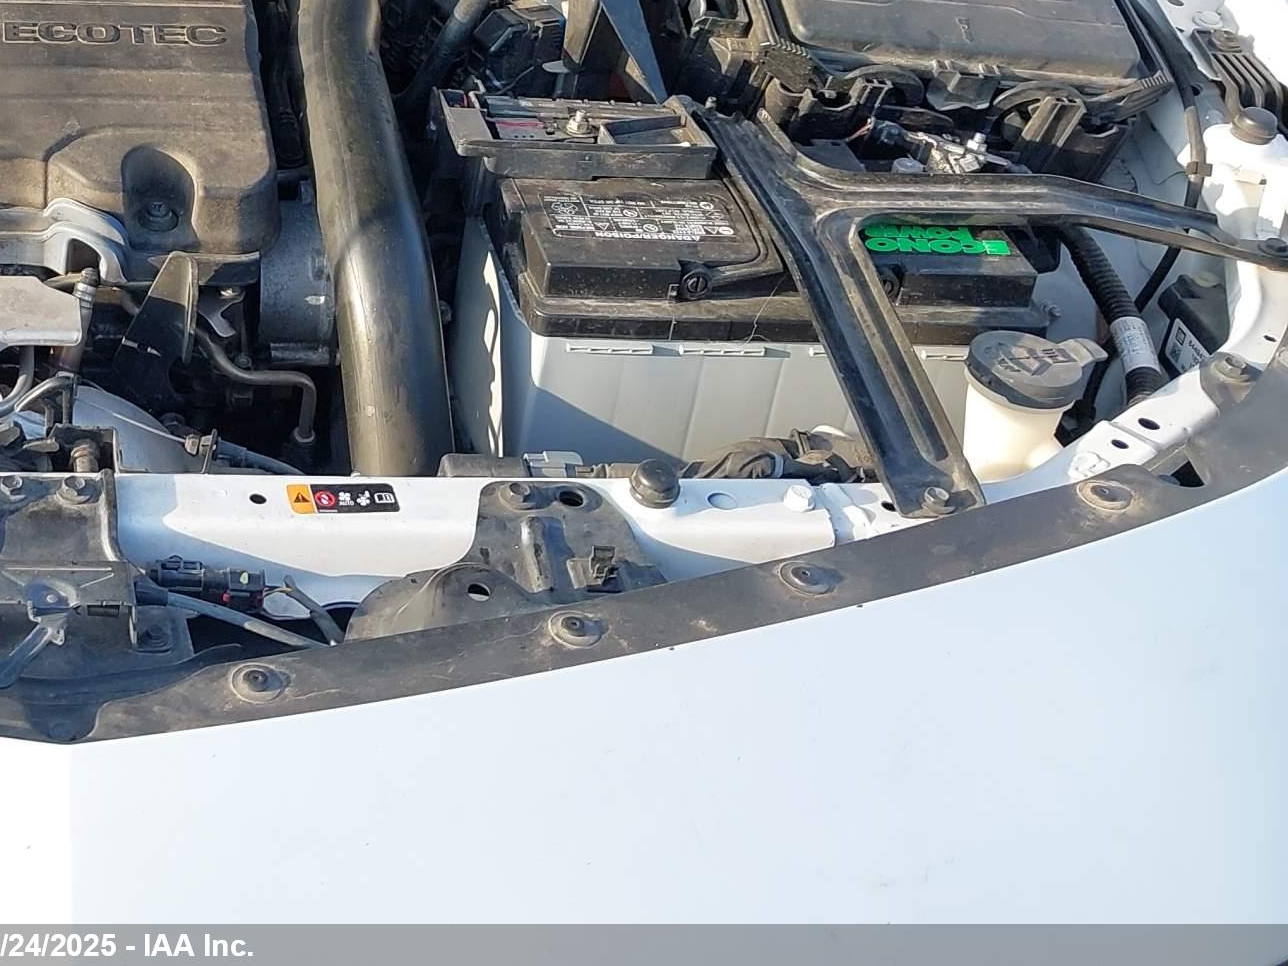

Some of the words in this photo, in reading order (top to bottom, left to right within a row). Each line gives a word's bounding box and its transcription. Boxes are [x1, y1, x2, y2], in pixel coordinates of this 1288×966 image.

[2, 20, 227, 46] ECOTEC
[594, 232, 691, 242] DANGER/POISON
[864, 237, 1011, 256] ECONO
